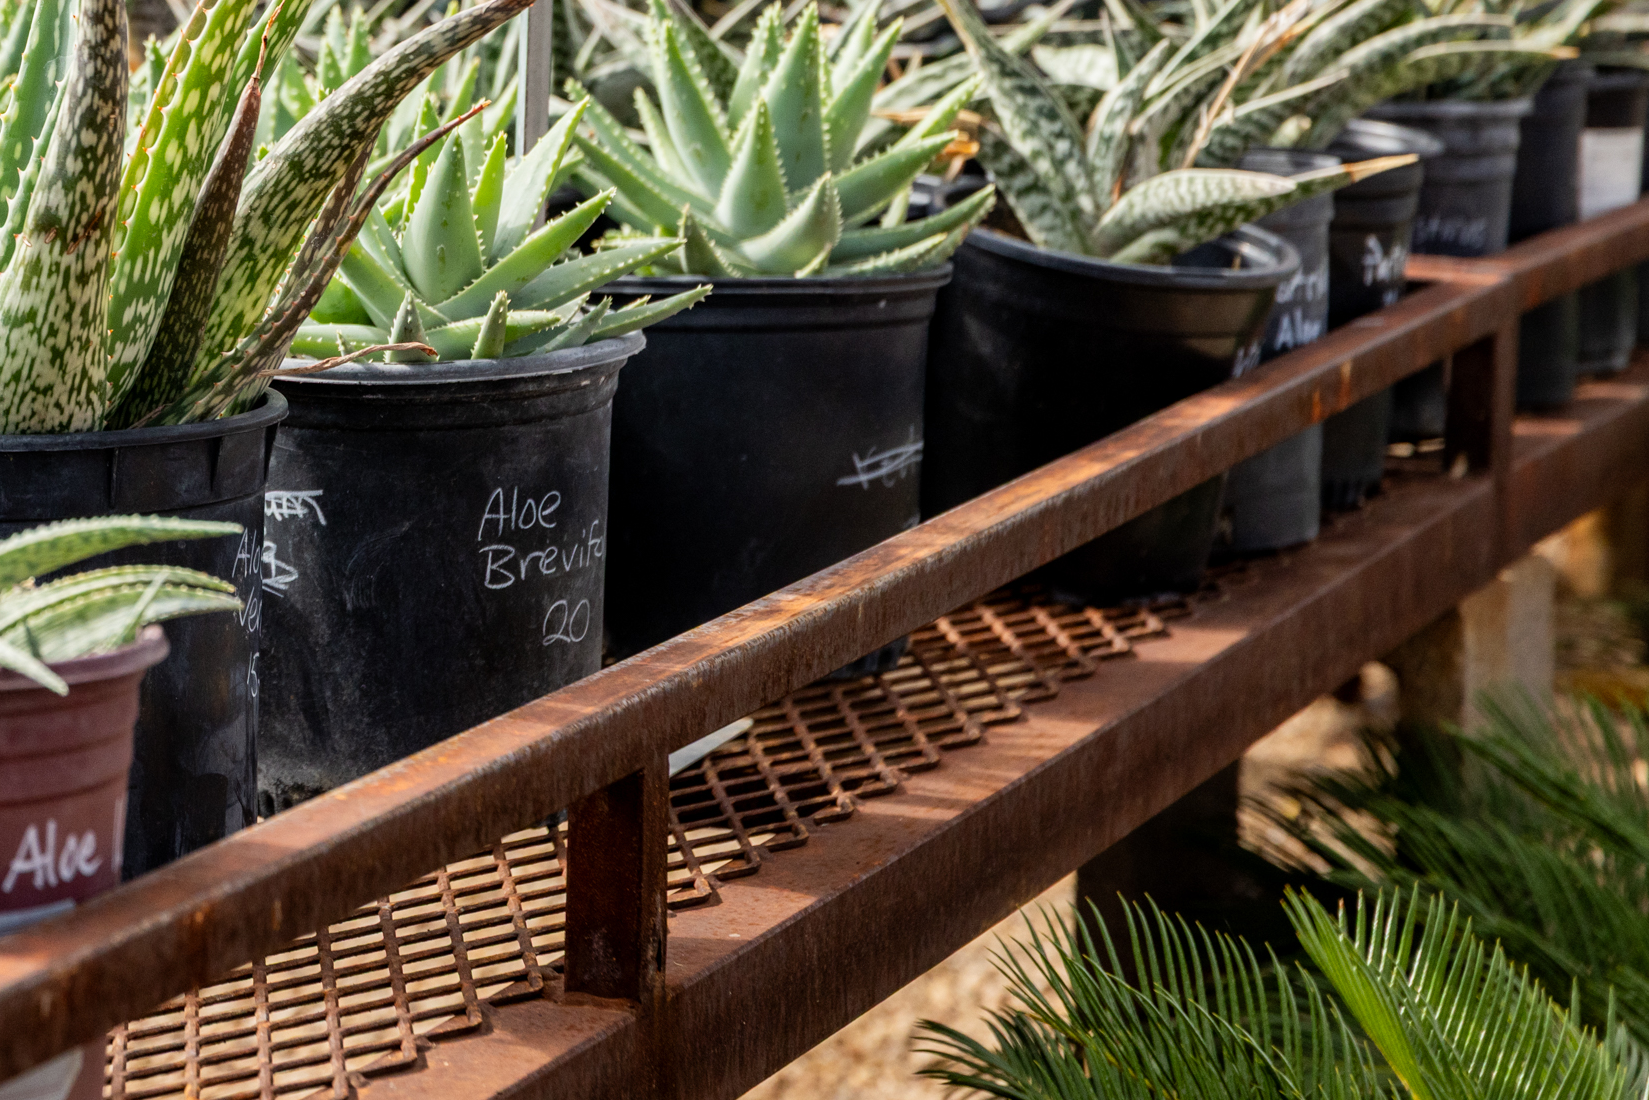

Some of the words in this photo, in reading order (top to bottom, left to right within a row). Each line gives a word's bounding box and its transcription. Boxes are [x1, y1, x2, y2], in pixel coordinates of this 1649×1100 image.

[478, 485, 561, 541] Aloe
[542, 599, 591, 646] 20
[2, 818, 102, 894] Aloe
